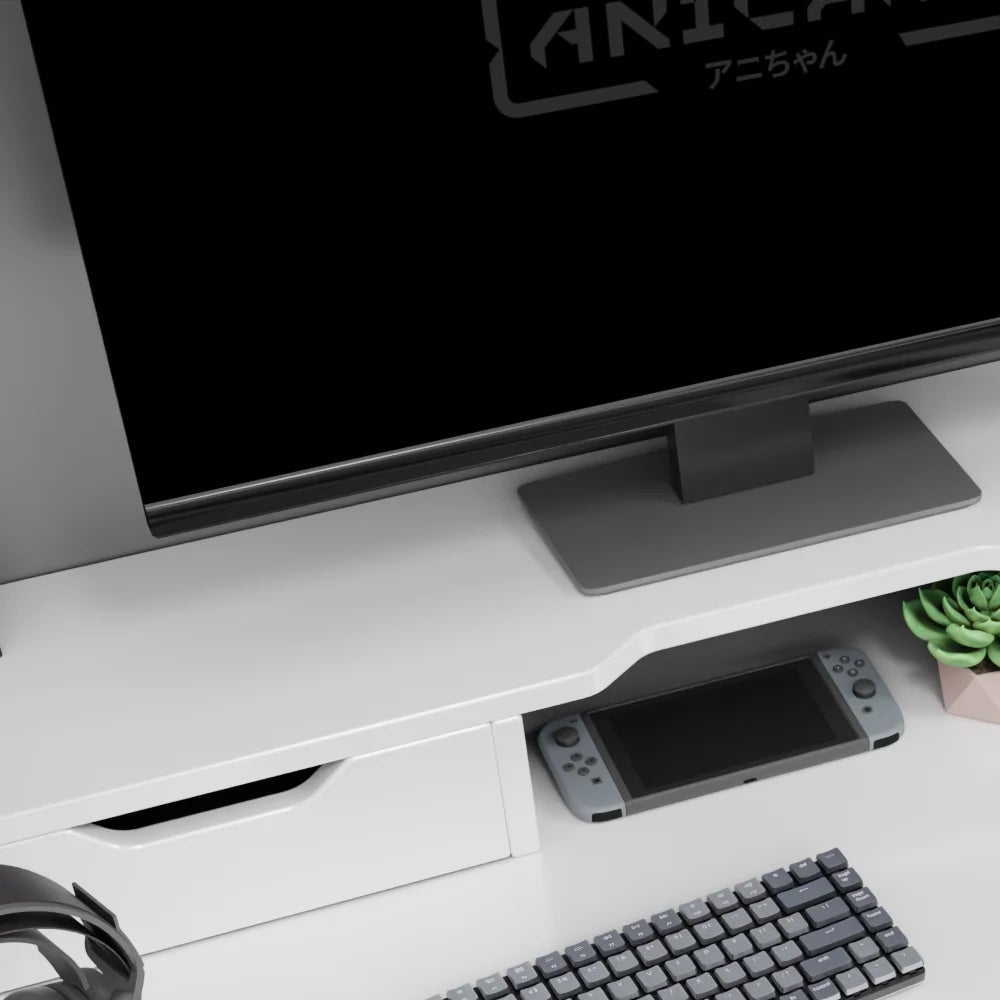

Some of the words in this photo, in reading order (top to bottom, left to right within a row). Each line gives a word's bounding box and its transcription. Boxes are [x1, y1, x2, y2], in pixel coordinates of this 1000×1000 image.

[705, 40, 848, 89] アニちゃん
